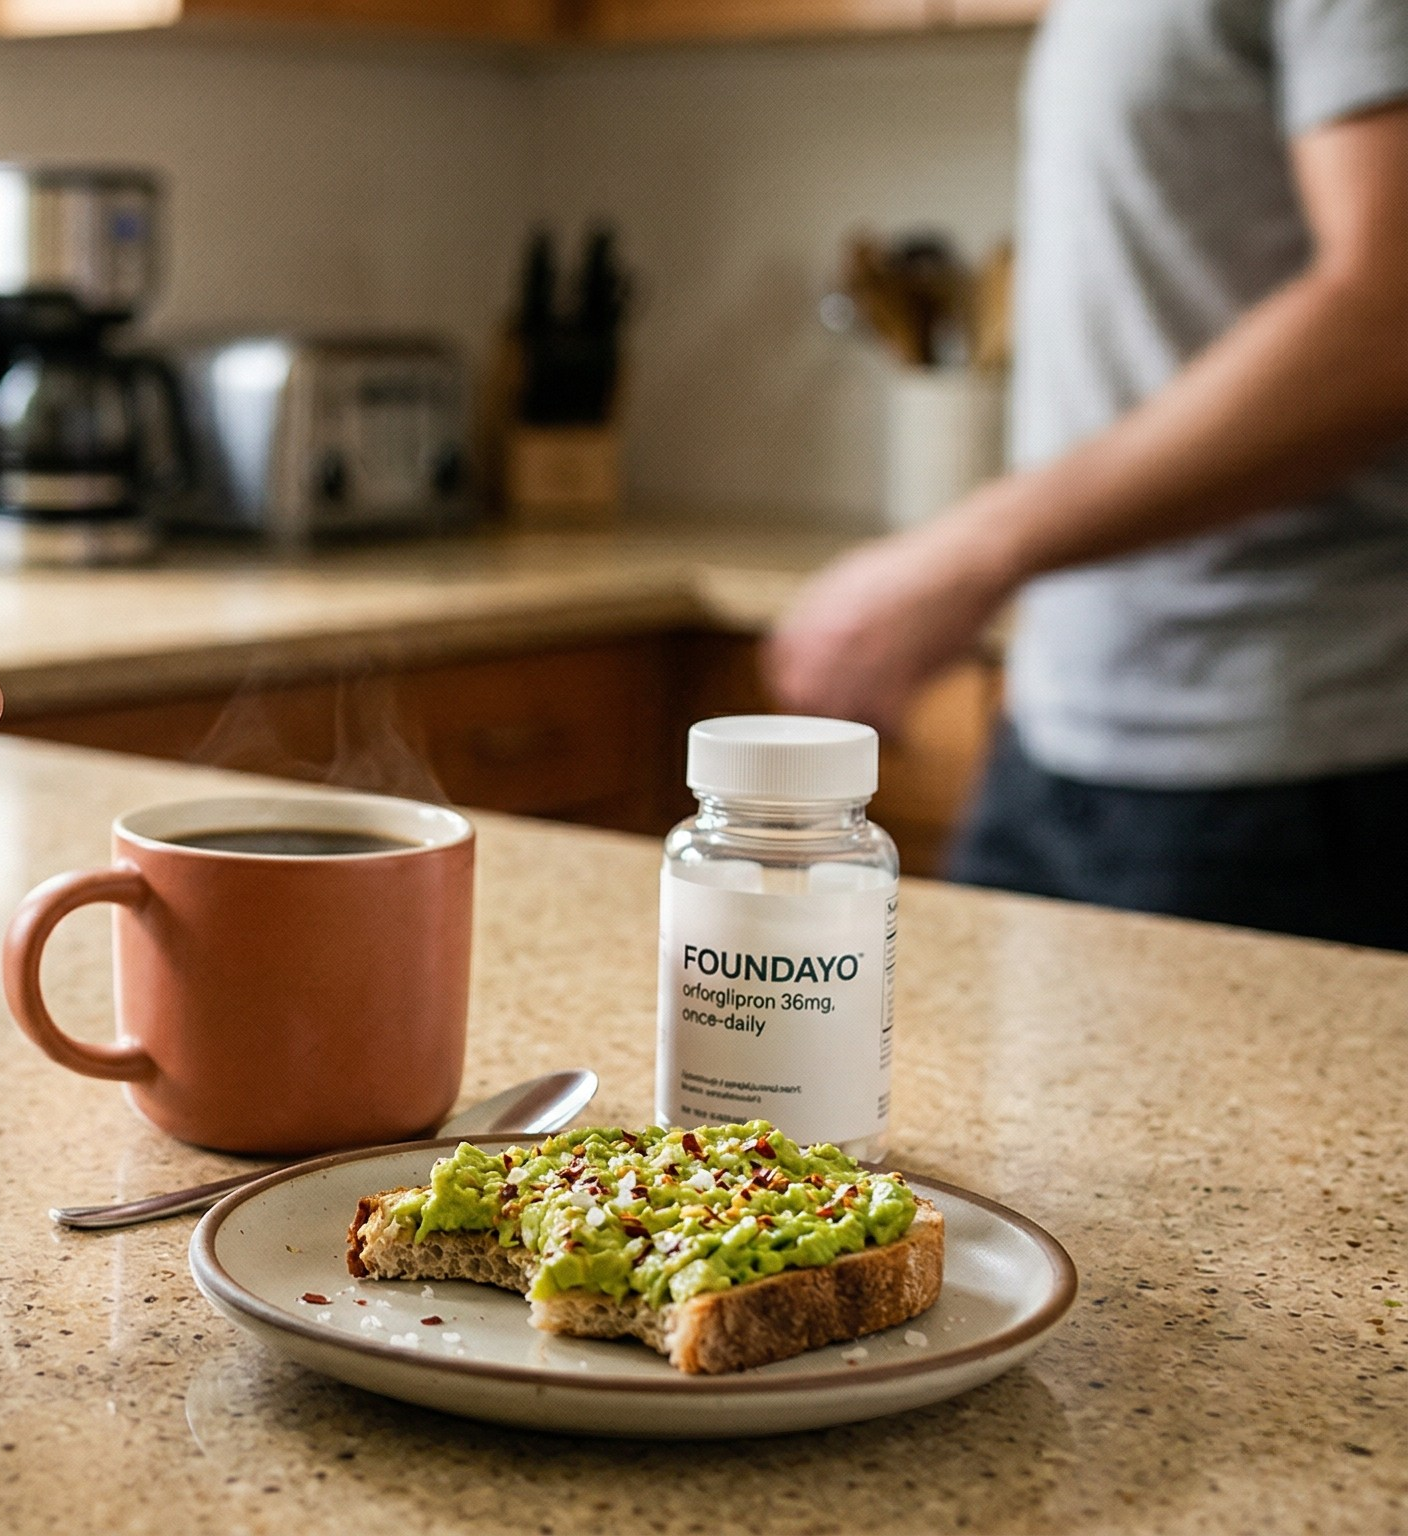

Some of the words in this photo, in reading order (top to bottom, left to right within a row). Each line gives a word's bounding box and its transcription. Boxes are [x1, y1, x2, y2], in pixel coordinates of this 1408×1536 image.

[682, 982, 776, 1010] orforglipron
[780, 993, 835, 1014] 36mg,
[682, 1008, 766, 1037] once-daily
